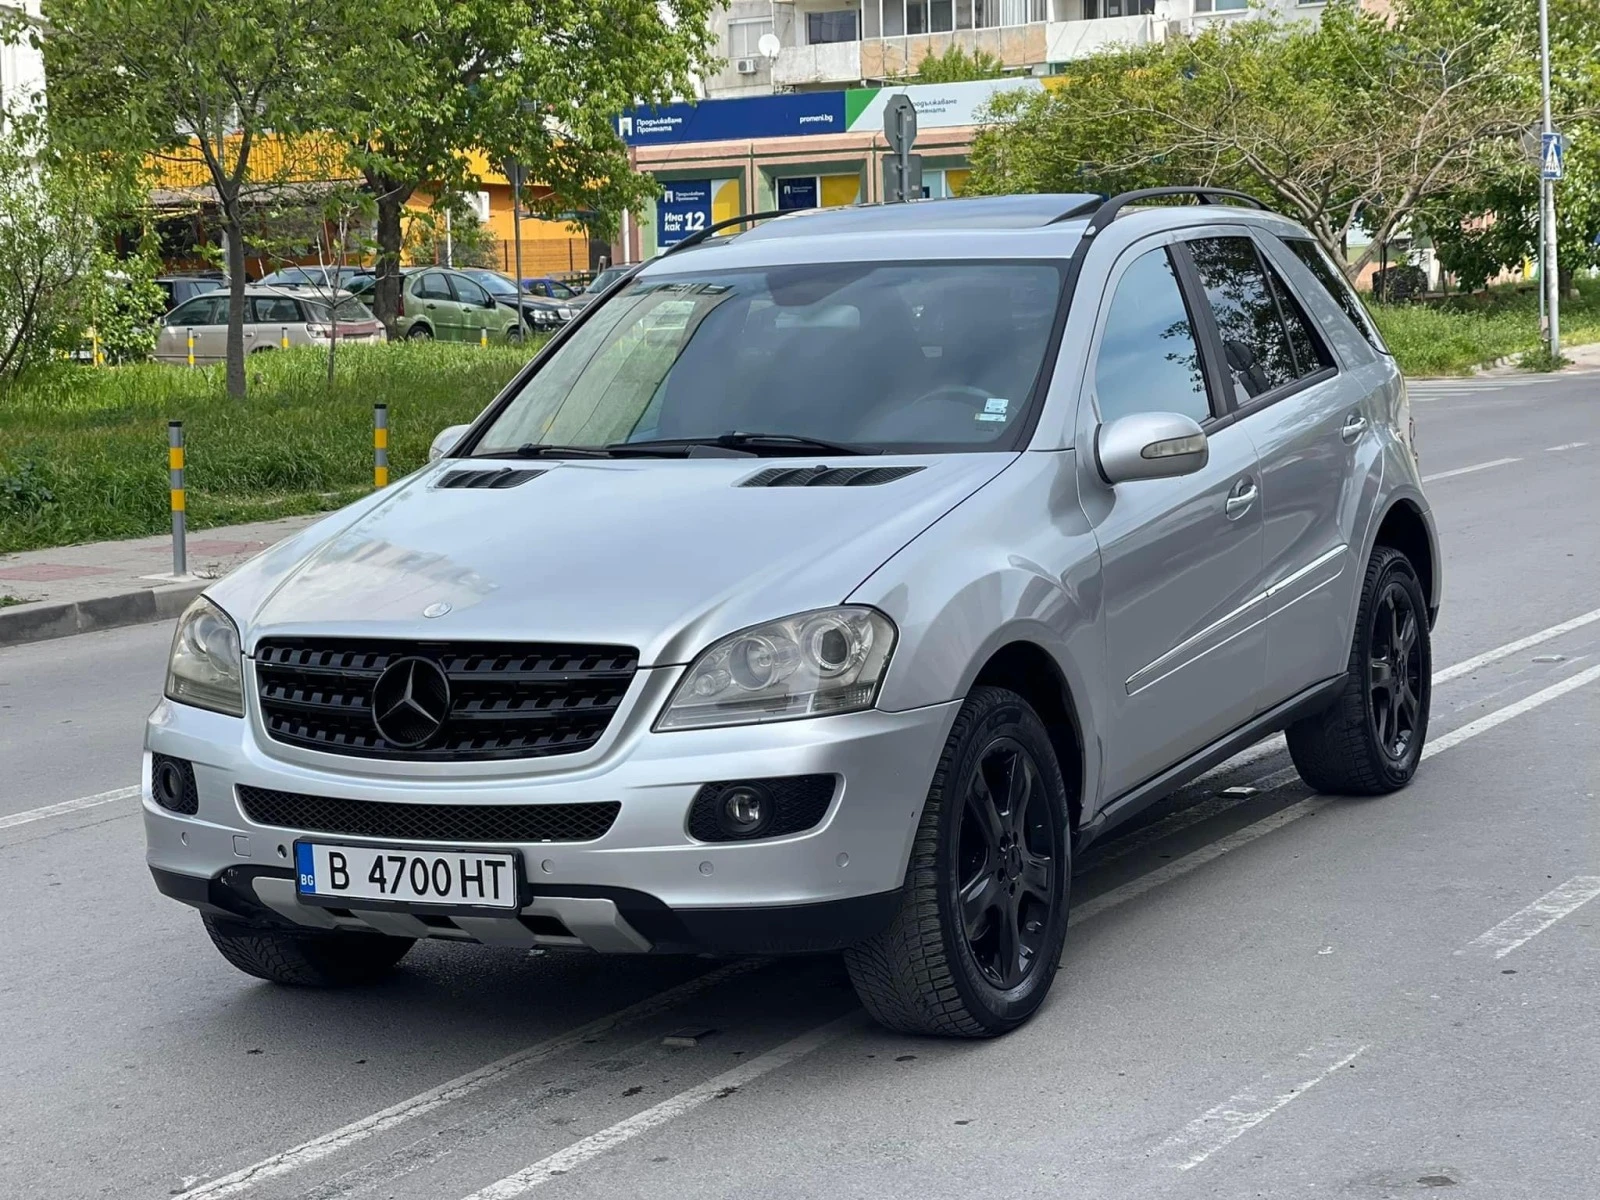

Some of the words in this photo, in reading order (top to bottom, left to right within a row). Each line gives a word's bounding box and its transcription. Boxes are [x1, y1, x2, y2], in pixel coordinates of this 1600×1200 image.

[636, 116, 683, 127] Продължаване
[799, 114, 833, 124] promeni.bg
[636, 125, 673, 135] Промяната
[664, 212, 684, 222] Има
[685, 211, 706, 231] 12
[664, 221, 681, 231] как
[328, 851, 350, 890] B
[300, 873, 314, 887] BG
